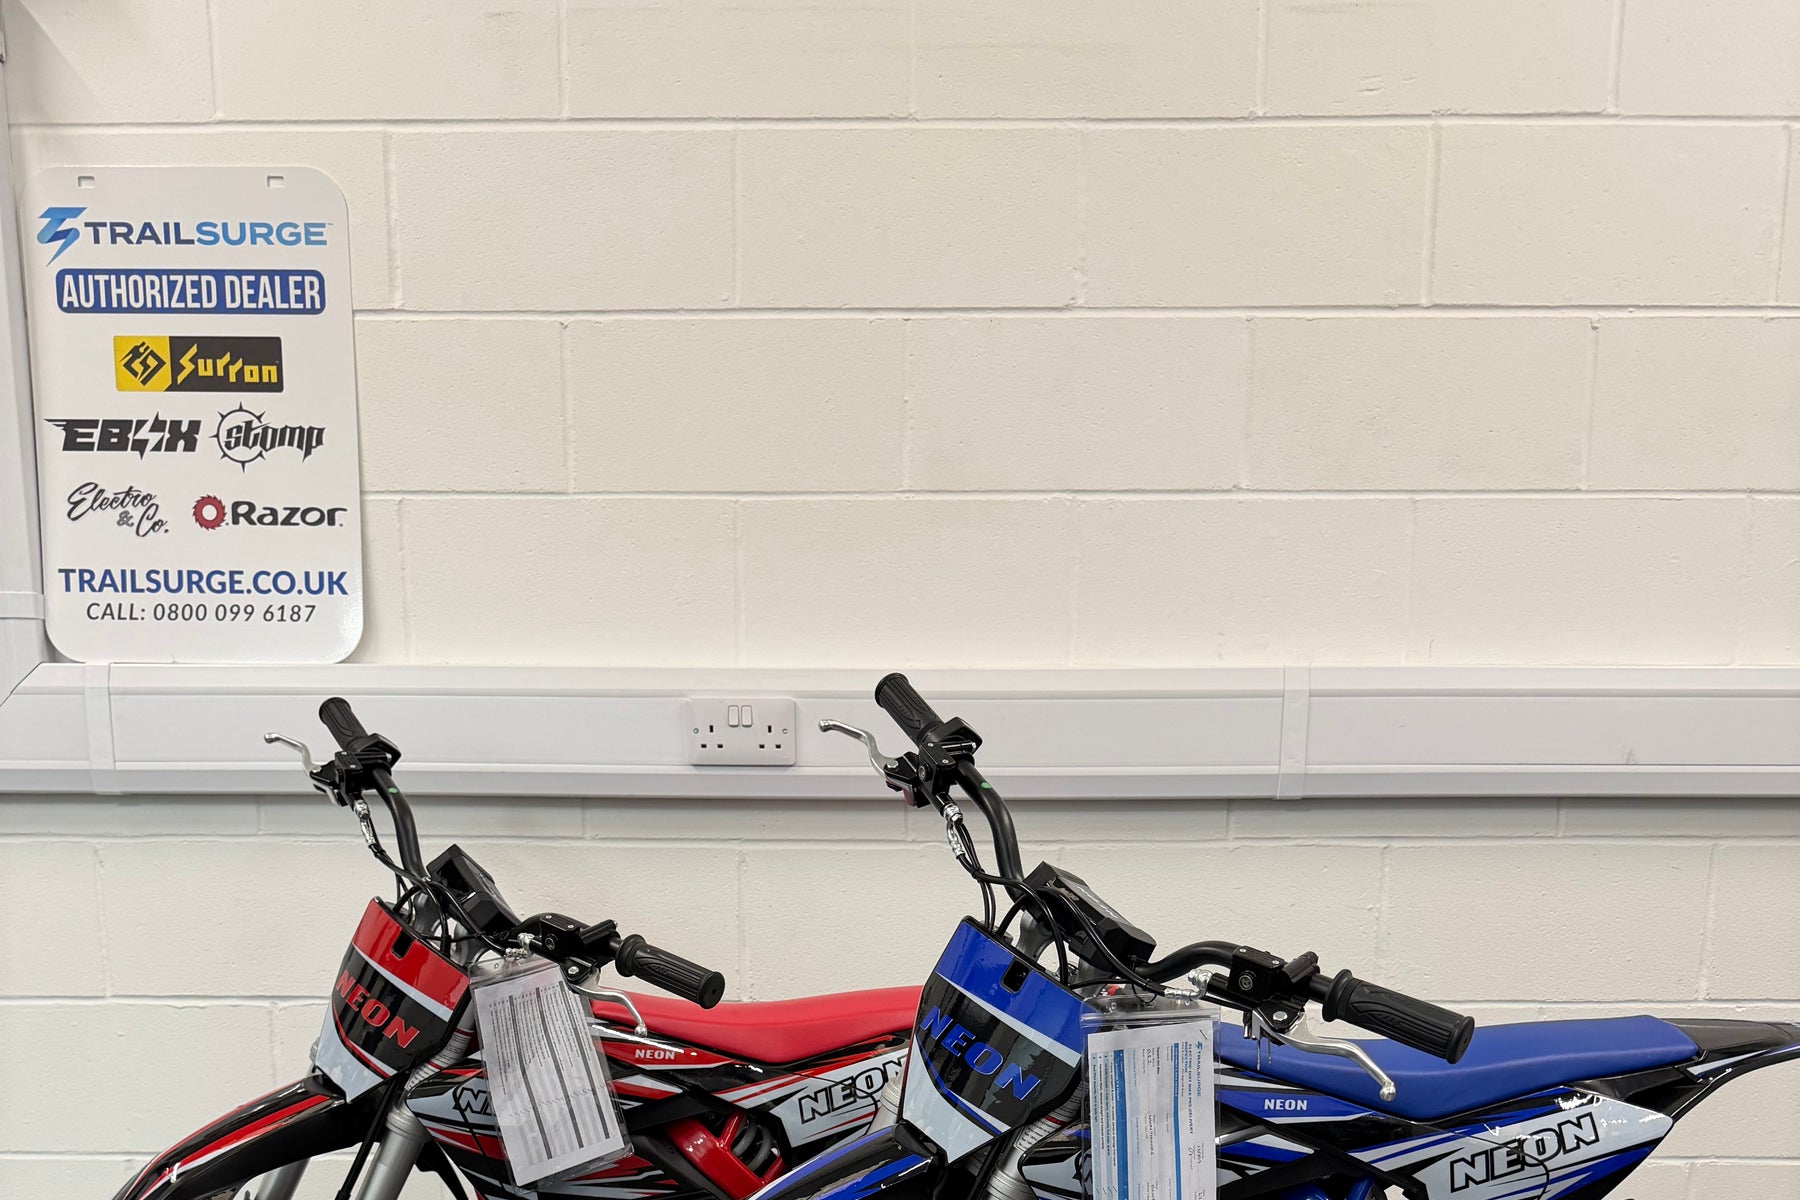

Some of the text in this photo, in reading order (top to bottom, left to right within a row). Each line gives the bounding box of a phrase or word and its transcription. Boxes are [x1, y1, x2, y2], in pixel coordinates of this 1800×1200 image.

[83, 221, 328, 247] TRAILSURGE
[62, 274, 323, 310] AUTHORIZED DEALER
[66, 481, 156, 523] Electro
[231, 500, 346, 528] Razor
[115, 502, 170, 538] & Co.
[57, 567, 349, 596] TRAILSURGE.CO.UK
[86, 602, 317, 623] CALL: 0800 099 6187
[336, 970, 420, 1049] NEON
[634, 1049, 675, 1060] NEON
[919, 1005, 1041, 1101] NEON
[1264, 1099, 1308, 1111] NEON
[1449, 1111, 1600, 1193] NEON
